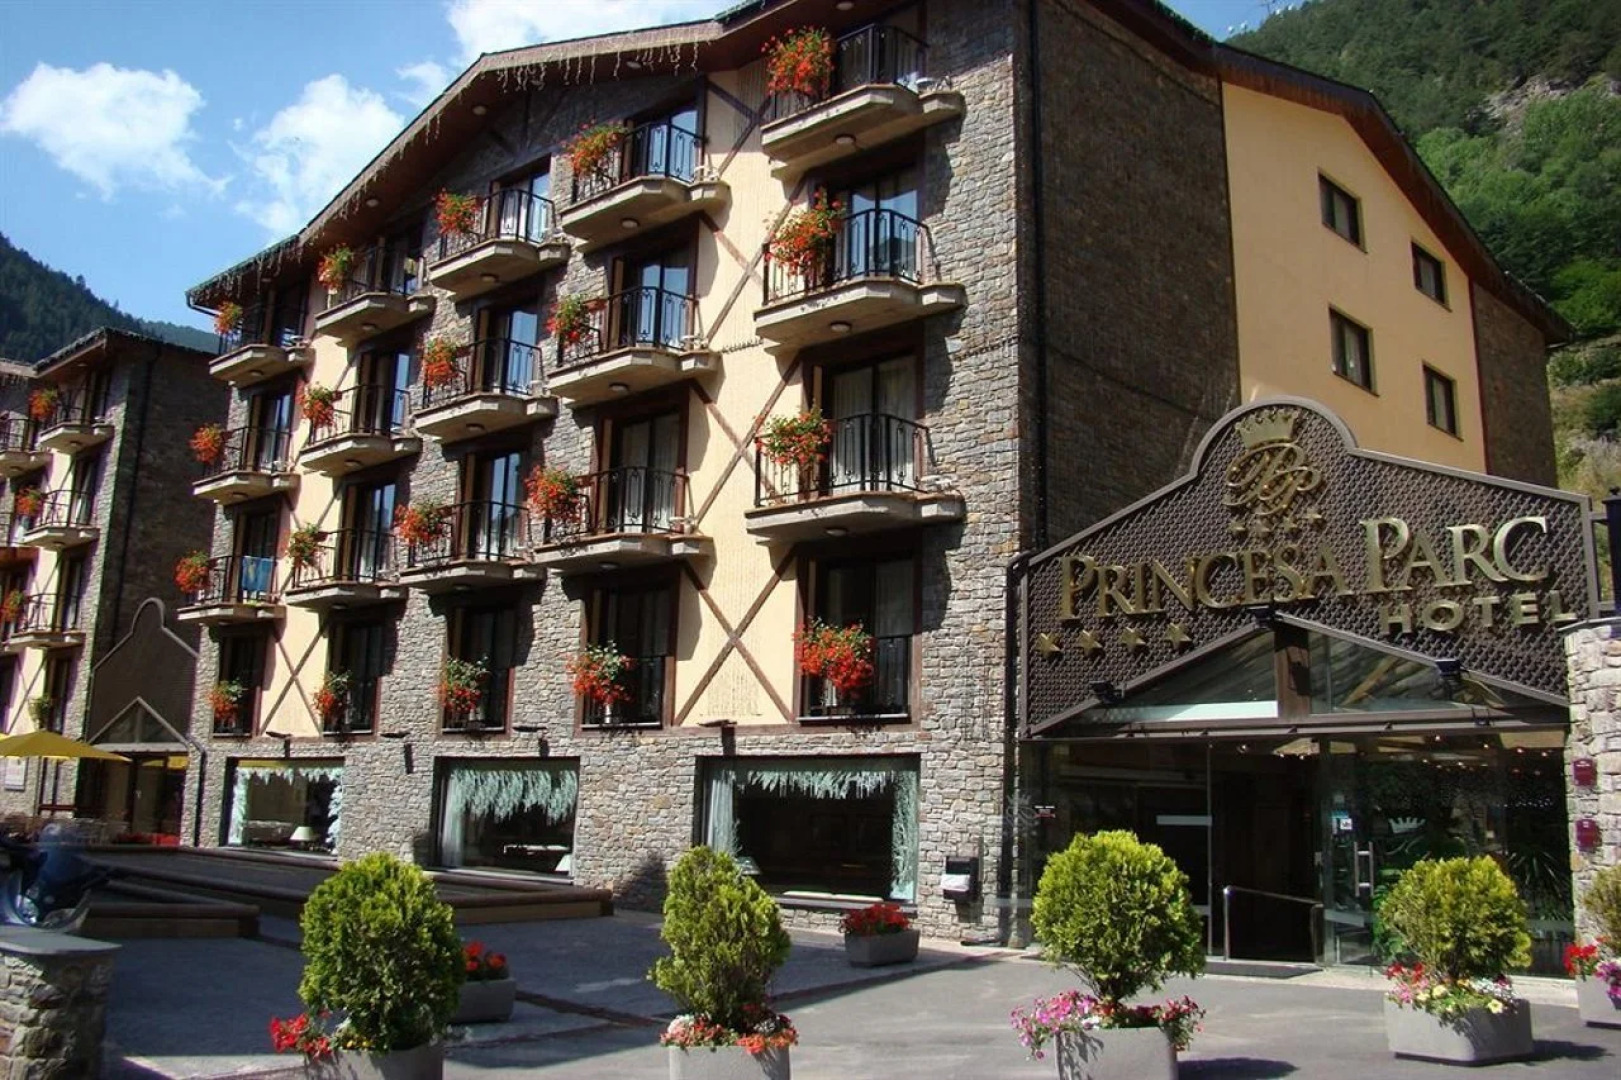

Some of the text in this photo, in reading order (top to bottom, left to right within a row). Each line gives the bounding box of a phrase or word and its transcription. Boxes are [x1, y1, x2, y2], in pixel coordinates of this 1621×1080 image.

[1056, 516, 1549, 620] PRINCESA PARC
[1379, 589, 1577, 635] HOTEL
